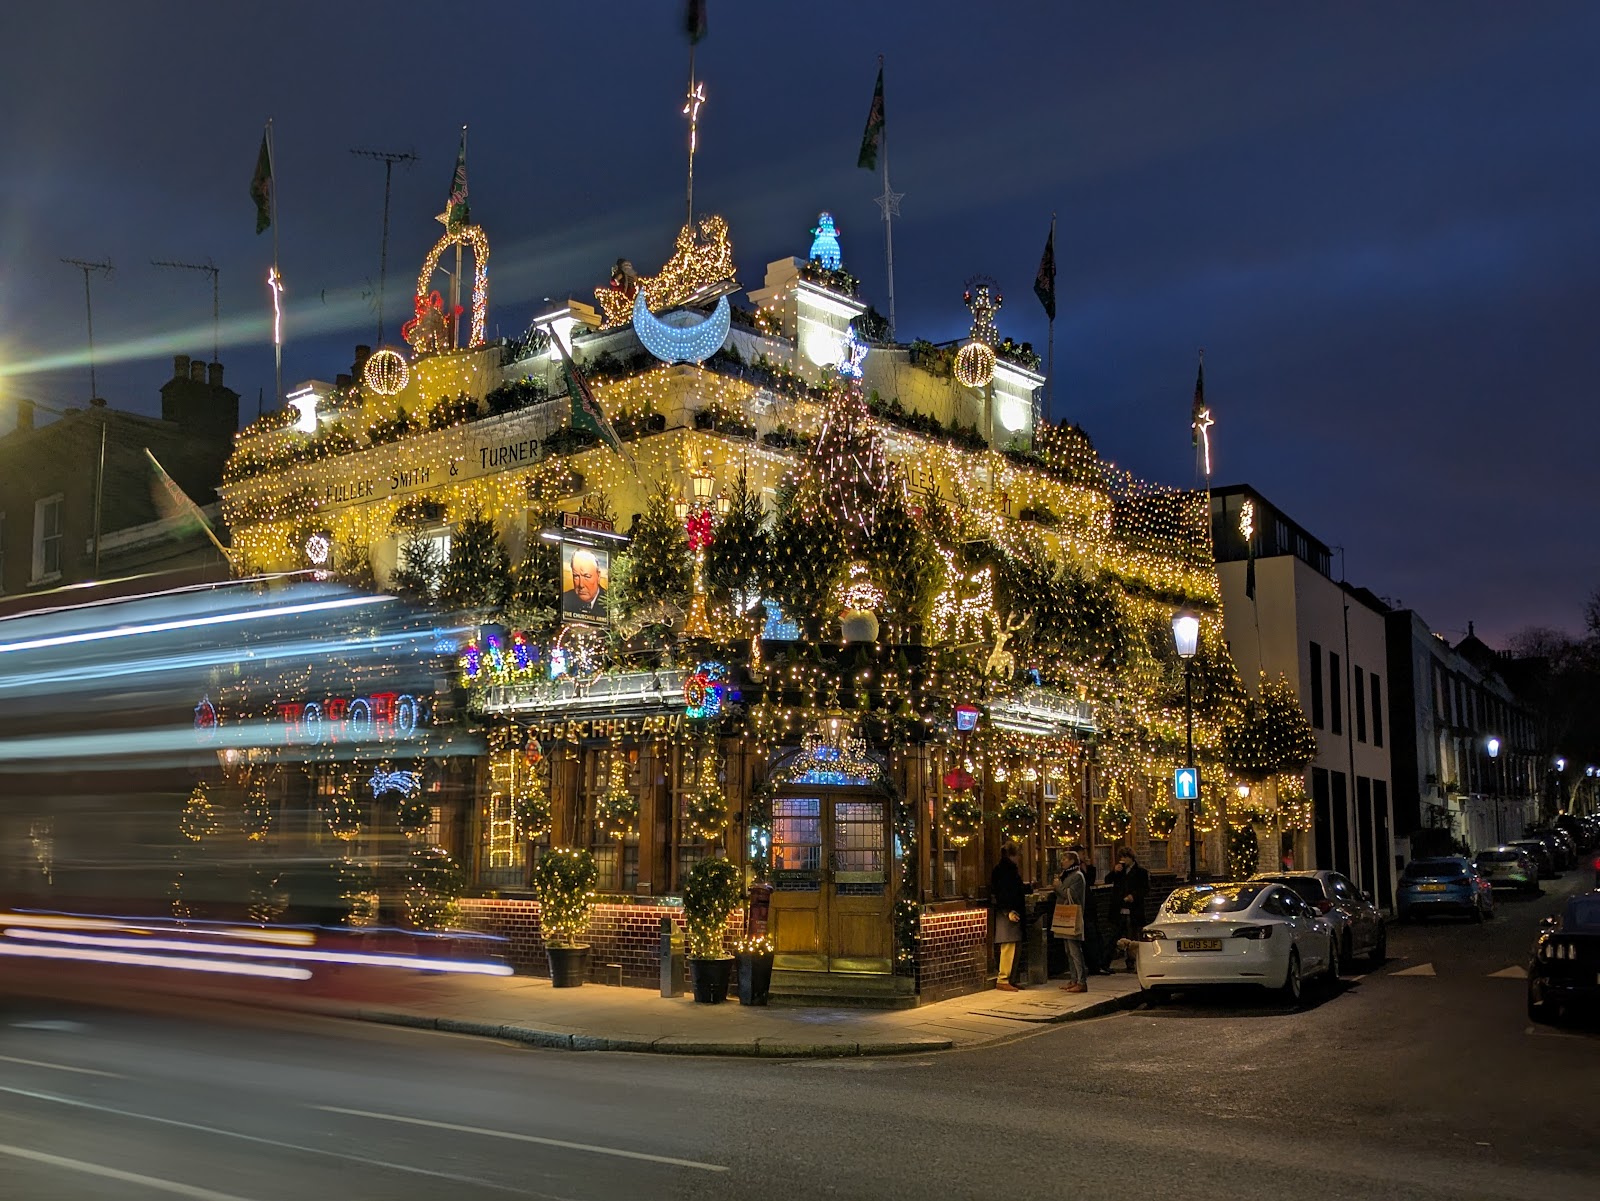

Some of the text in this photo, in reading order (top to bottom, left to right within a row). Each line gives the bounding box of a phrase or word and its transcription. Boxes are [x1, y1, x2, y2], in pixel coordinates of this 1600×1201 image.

[326, 439, 539, 505] FULLER SMITH & TURNER
[1183, 940, 1218, 949] LG19 SJF
